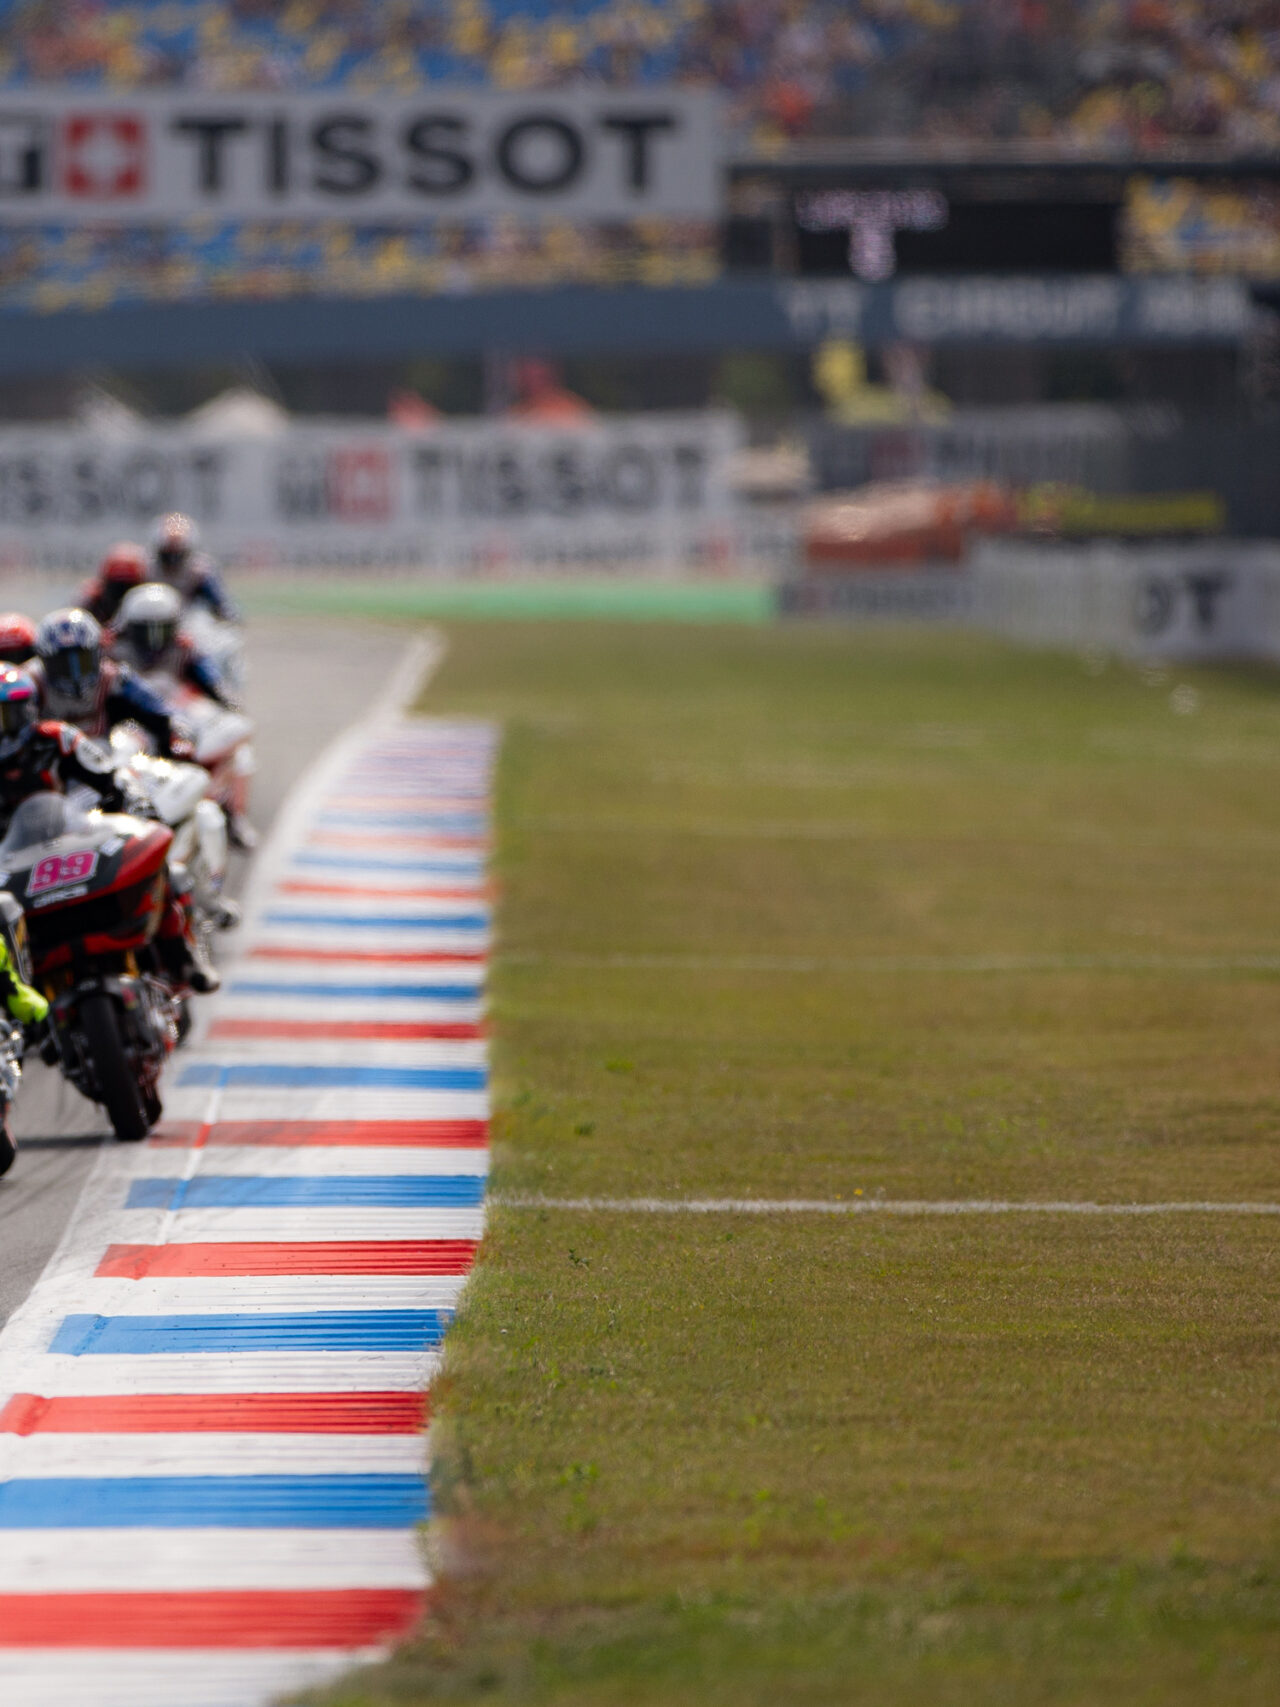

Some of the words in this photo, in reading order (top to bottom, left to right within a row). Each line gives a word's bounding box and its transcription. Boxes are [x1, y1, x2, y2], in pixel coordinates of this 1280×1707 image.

[171, 111, 677, 198] TISSOT
[413, 444, 709, 512] TISSOT
[28, 850, 97, 894] 99
